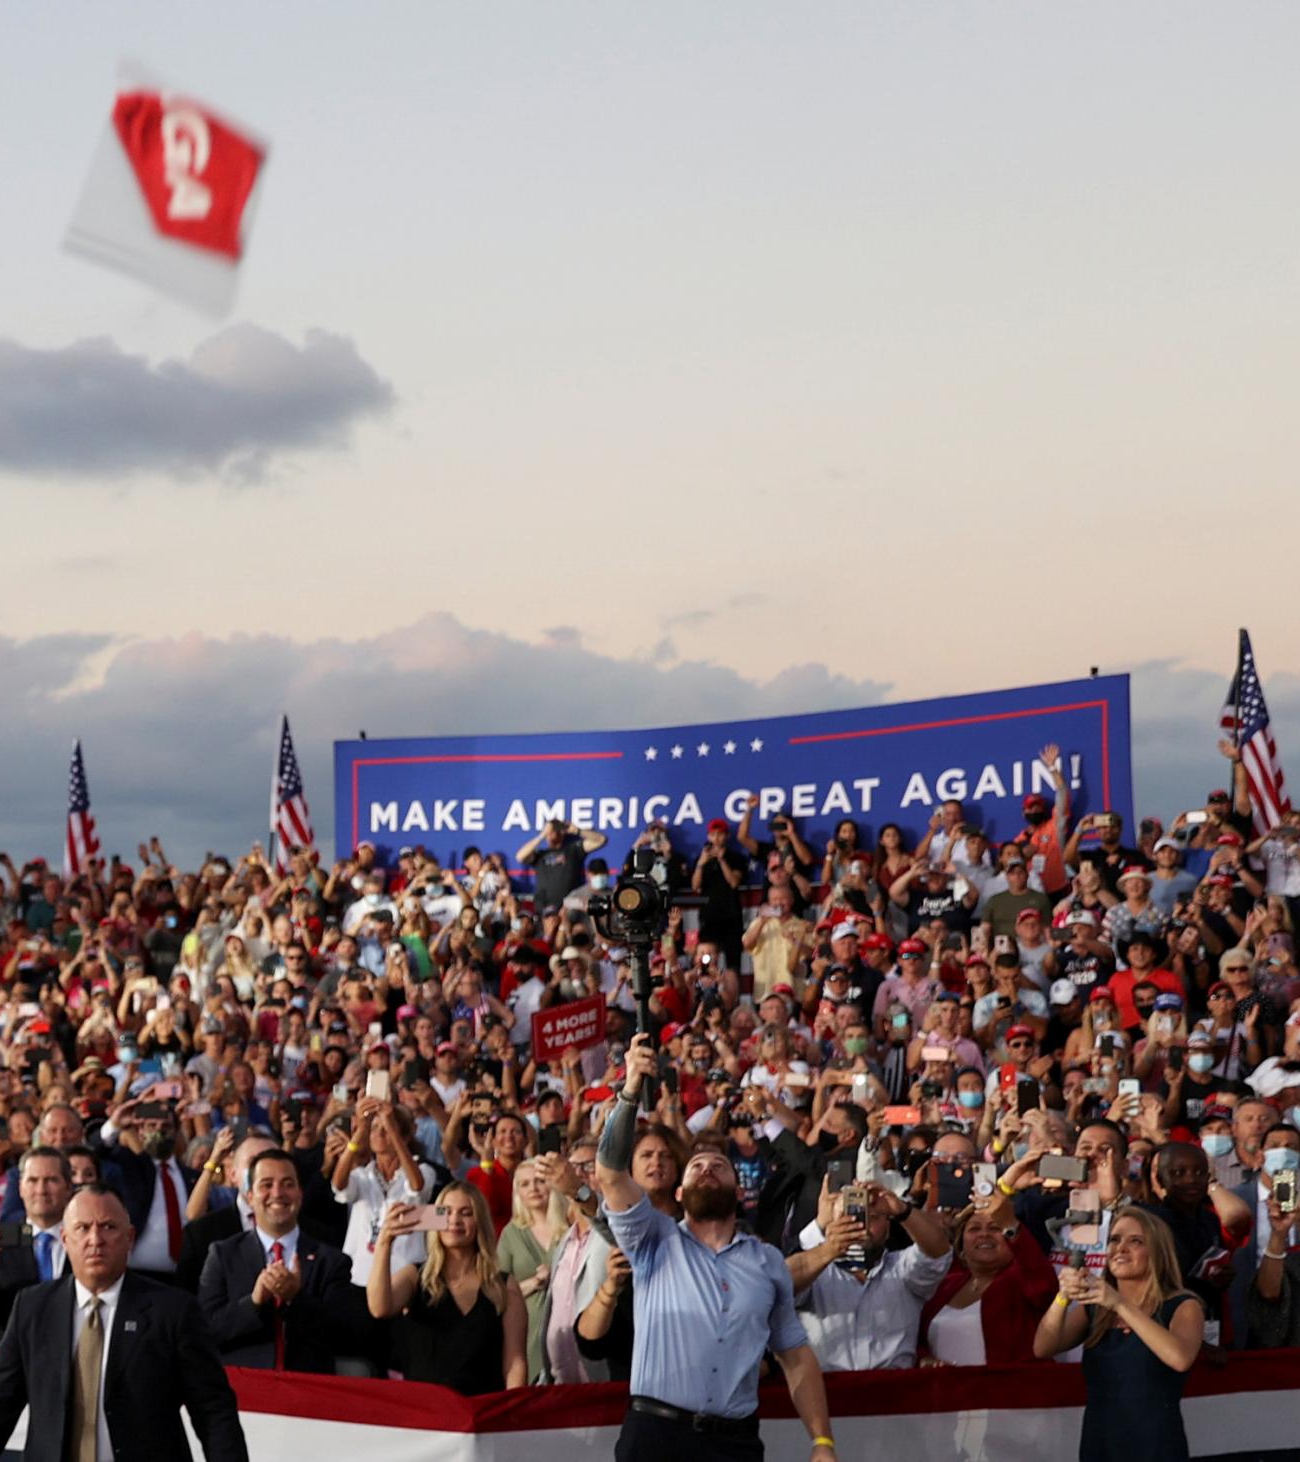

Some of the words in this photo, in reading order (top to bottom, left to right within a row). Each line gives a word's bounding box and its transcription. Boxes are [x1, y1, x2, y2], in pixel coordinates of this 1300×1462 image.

[369, 799, 486, 834] MAKE
[501, 791, 704, 833] AMERICA
[723, 777, 881, 823] GREAT
[900, 753, 1081, 808] AGAIN!
[542, 1022, 554, 1033] 4
[555, 1008, 598, 1031] MORE
[544, 1024, 597, 1048] YEARS!
